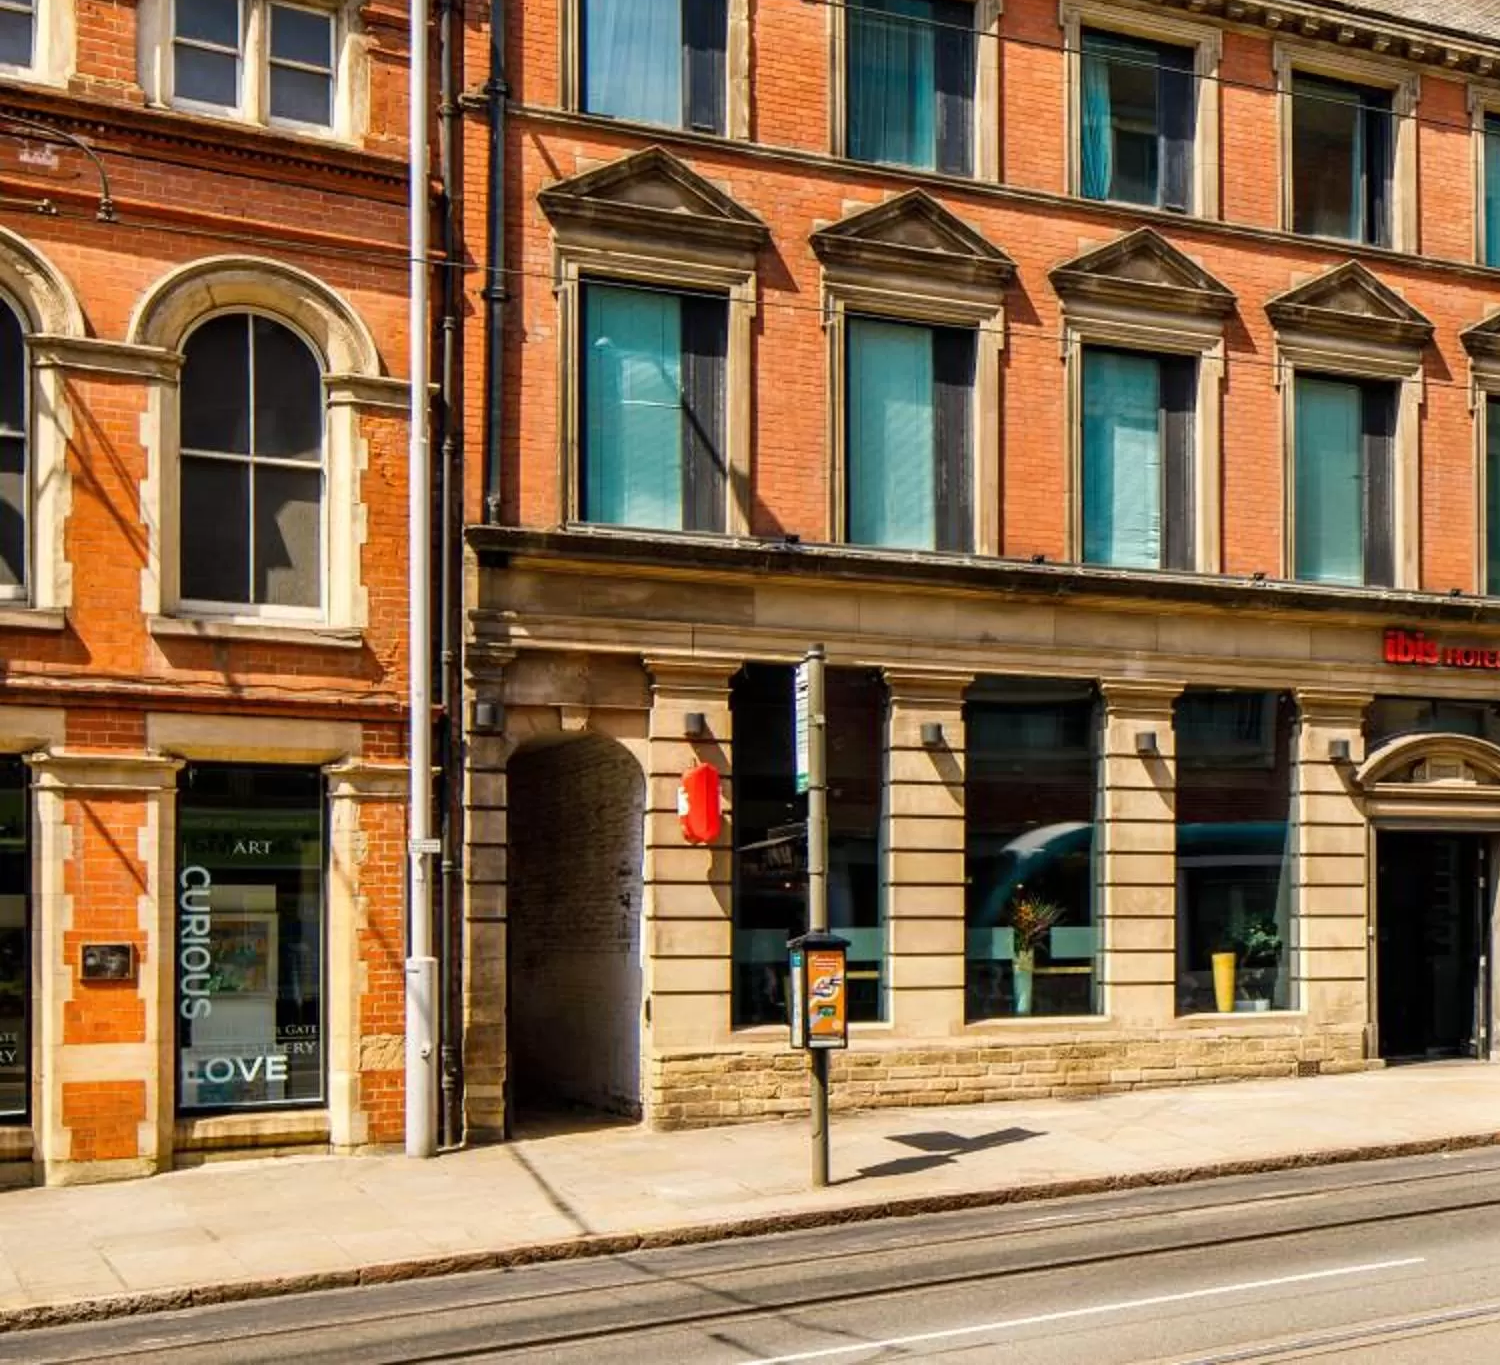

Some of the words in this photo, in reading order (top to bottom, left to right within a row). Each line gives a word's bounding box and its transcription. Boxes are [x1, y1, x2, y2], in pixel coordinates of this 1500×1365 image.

[1385, 629, 1439, 663] ibis
[231, 840, 273, 855] ART
[180, 866, 211, 1020] CURIOUS
[184, 1054, 289, 1083] LOVE
